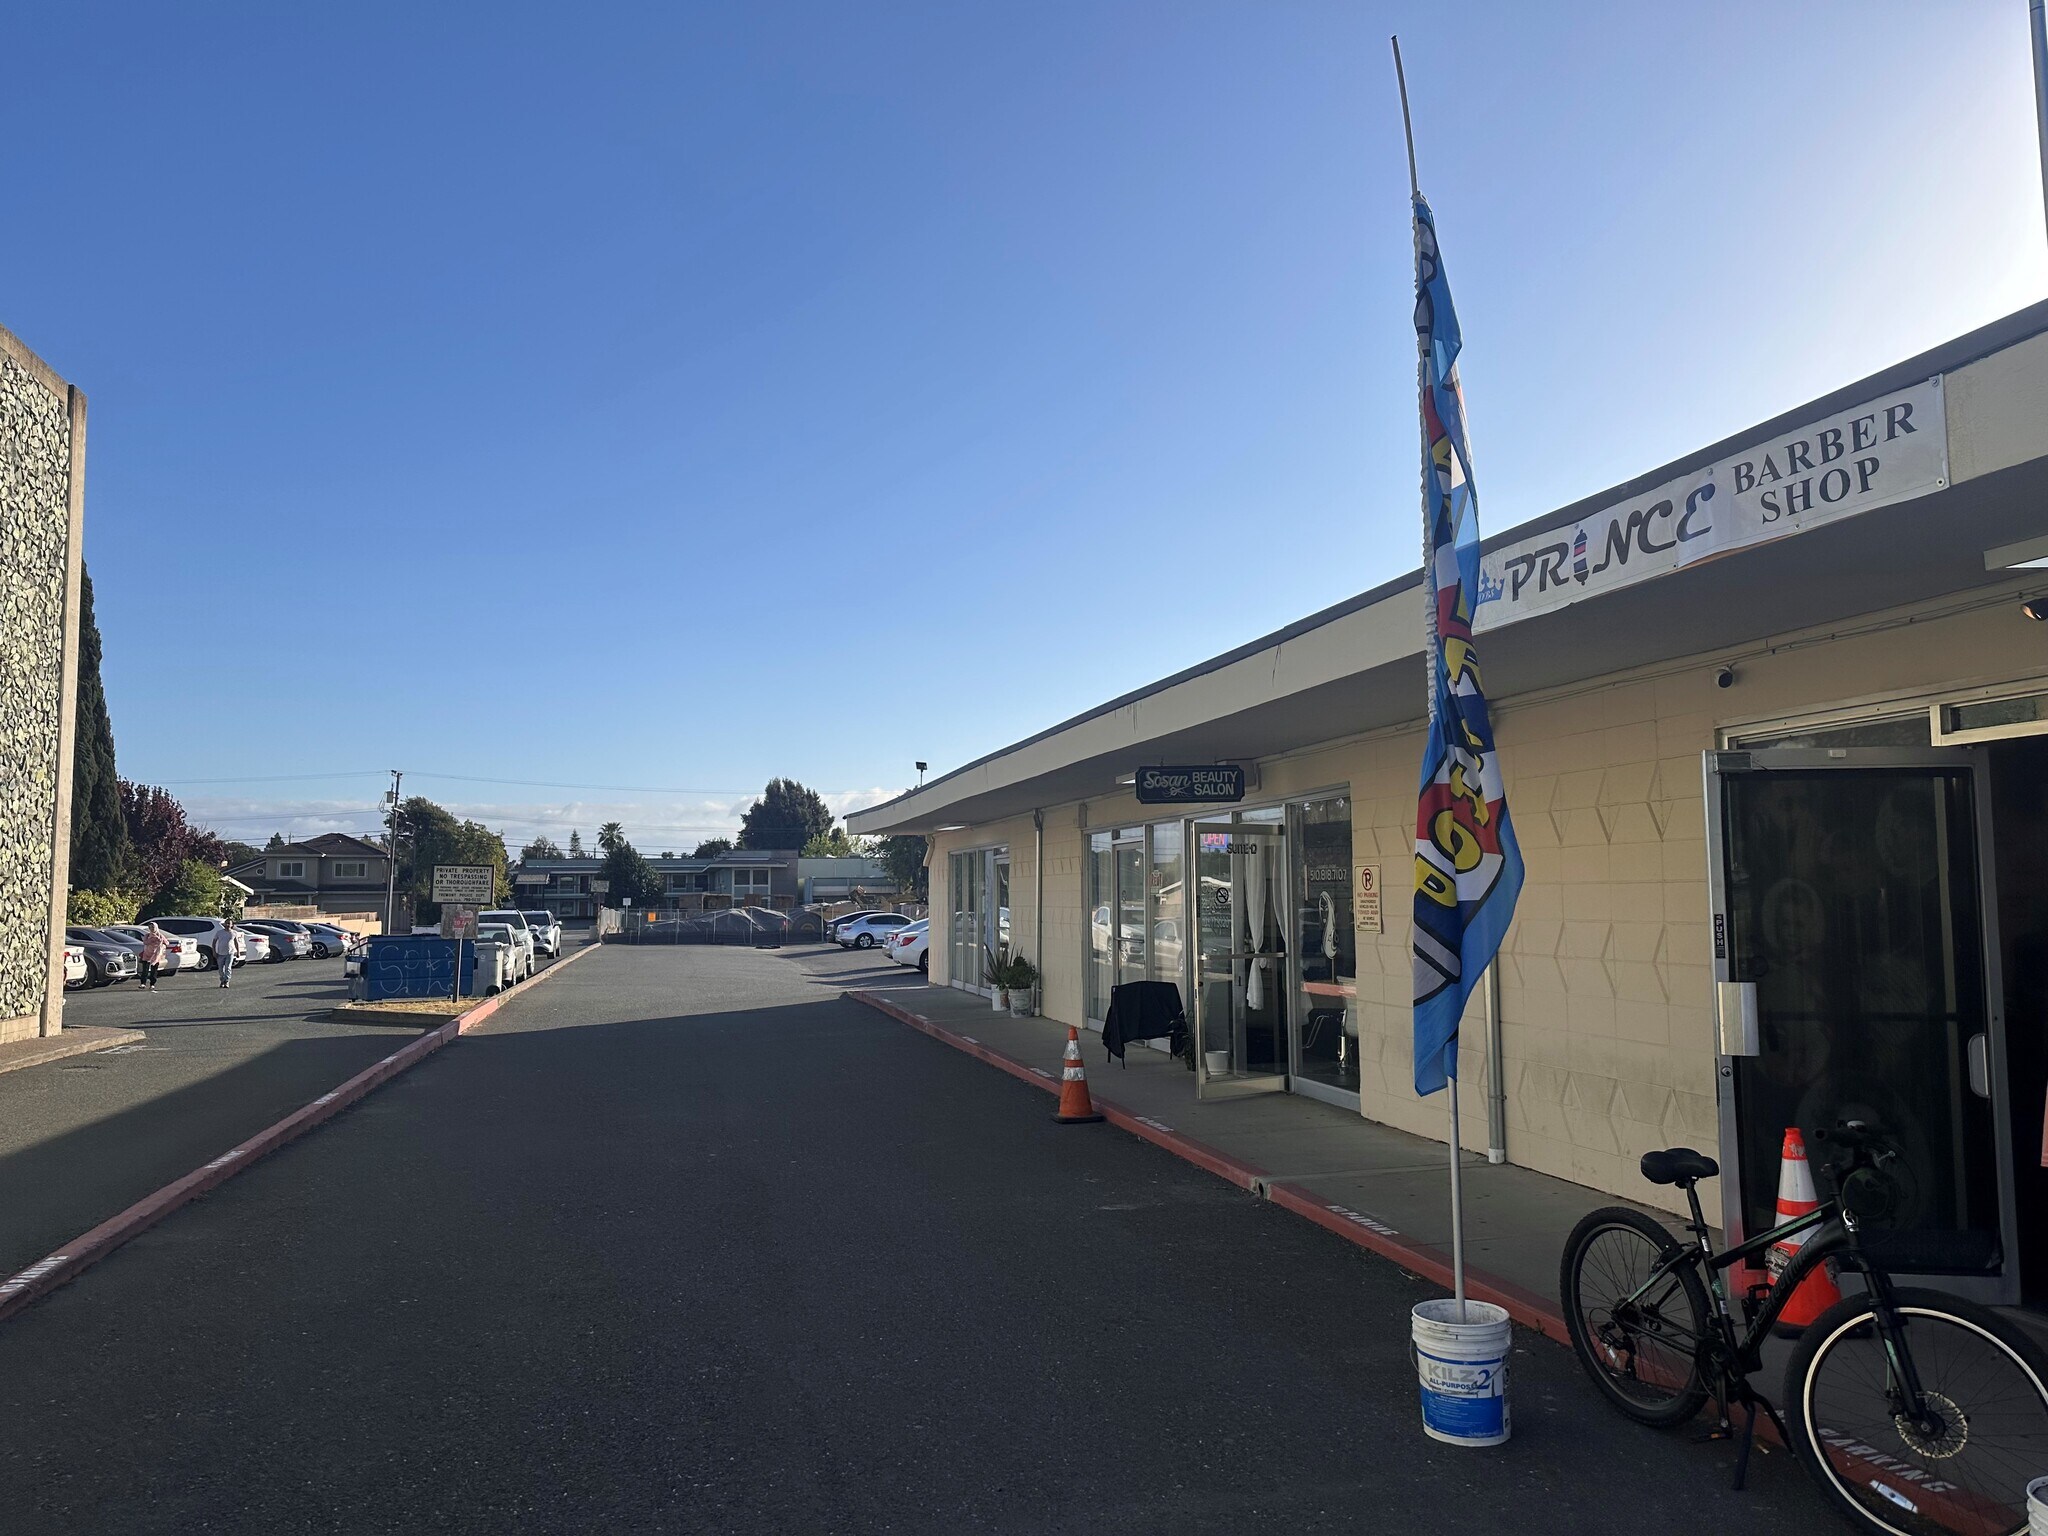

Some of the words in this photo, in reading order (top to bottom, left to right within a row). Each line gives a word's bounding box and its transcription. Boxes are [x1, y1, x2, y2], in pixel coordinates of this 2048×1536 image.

[1732, 402, 1918, 496] BARBER
[1761, 456, 1881, 525] SHOP
[1143, 771, 1191, 789] Sosan
[1192, 771, 1237, 783] BEAUTY
[1194, 784, 1235, 796] SALON
[1715, 919, 1724, 946] PUSH
[1427, 1363, 1475, 1383] KILZ
[1817, 1427, 1958, 1493] PARKING
